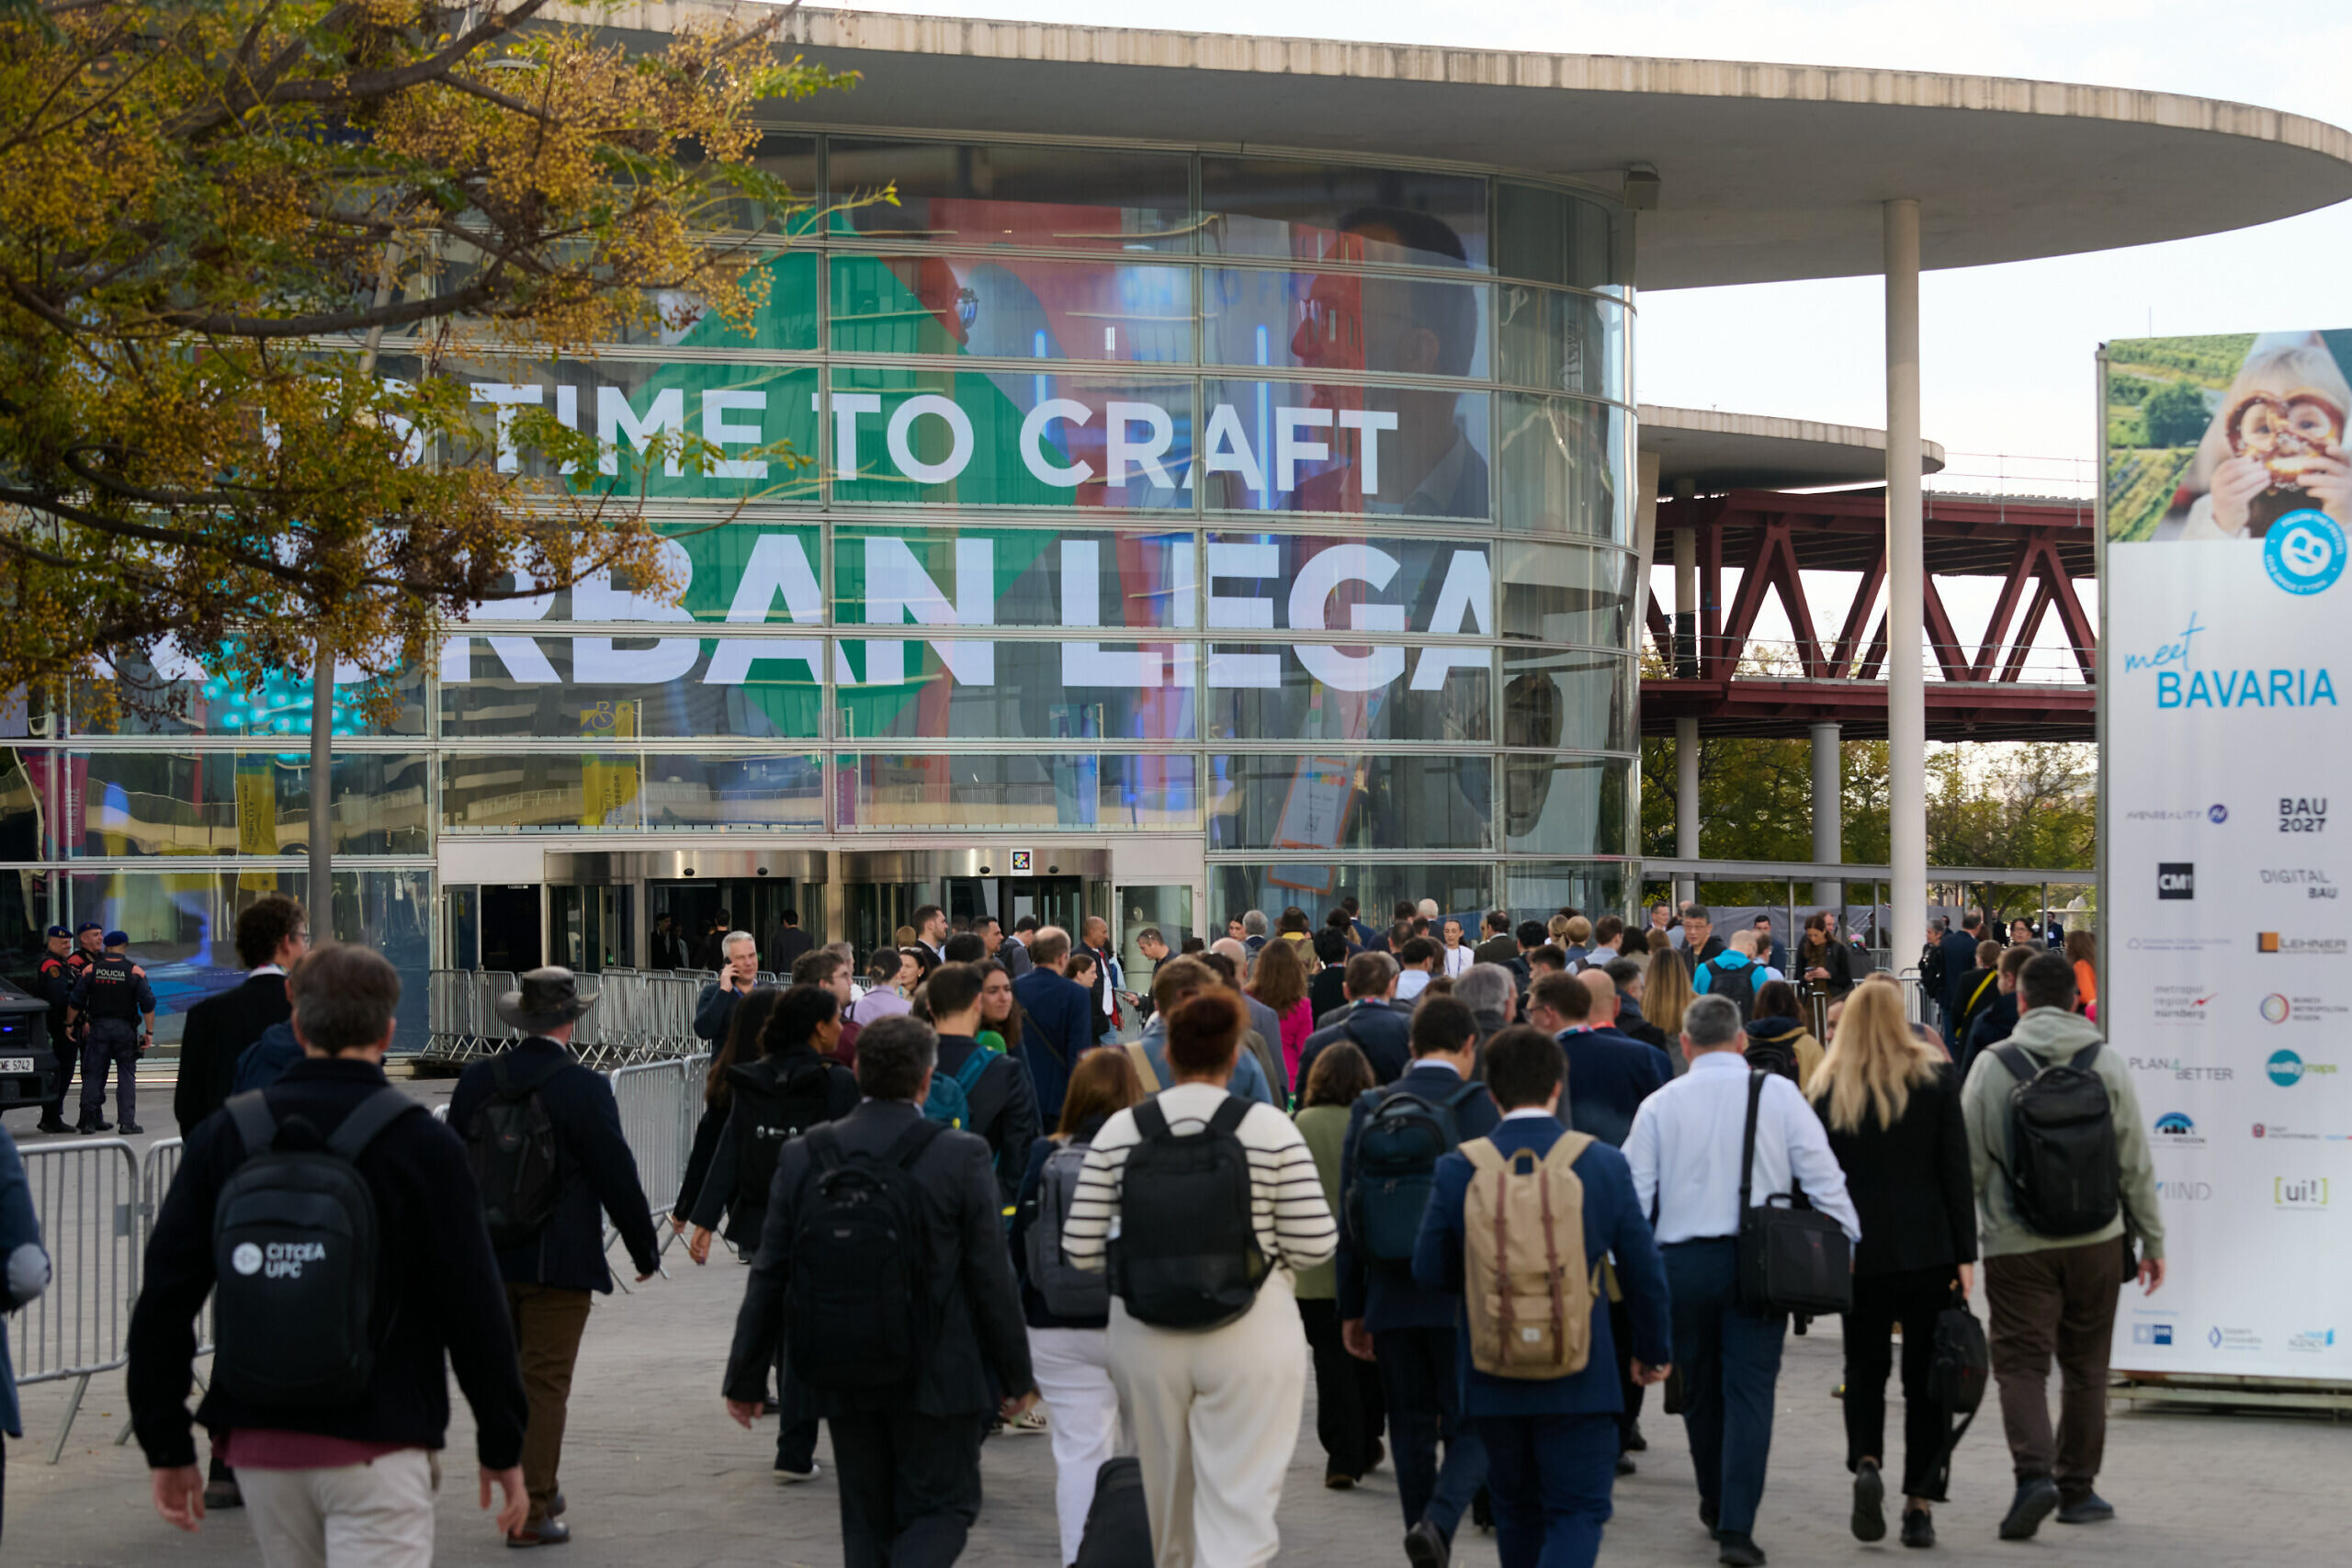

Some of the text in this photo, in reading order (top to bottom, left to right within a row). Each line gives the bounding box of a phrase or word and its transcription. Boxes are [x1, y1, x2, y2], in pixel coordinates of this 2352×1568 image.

[469, 382, 769, 479] TIME
[812, 392, 974, 485] TO
[1019, 397, 1398, 495] CRAFT
[1061, 537, 1491, 692] LEGA
[2125, 611, 2205, 673] meet
[2157, 668, 2337, 708] BAVARIA
[2279, 797, 2326, 816] BAU
[2278, 818, 2326, 832] 2027
[2259, 869, 2331, 884] DIGITAL
[2308, 887, 2337, 899] BAU
[13, 1060, 30, 1071] 5742
[2175, 1066, 2233, 1080] BETTER
[265, 1260, 302, 1279] UPC
